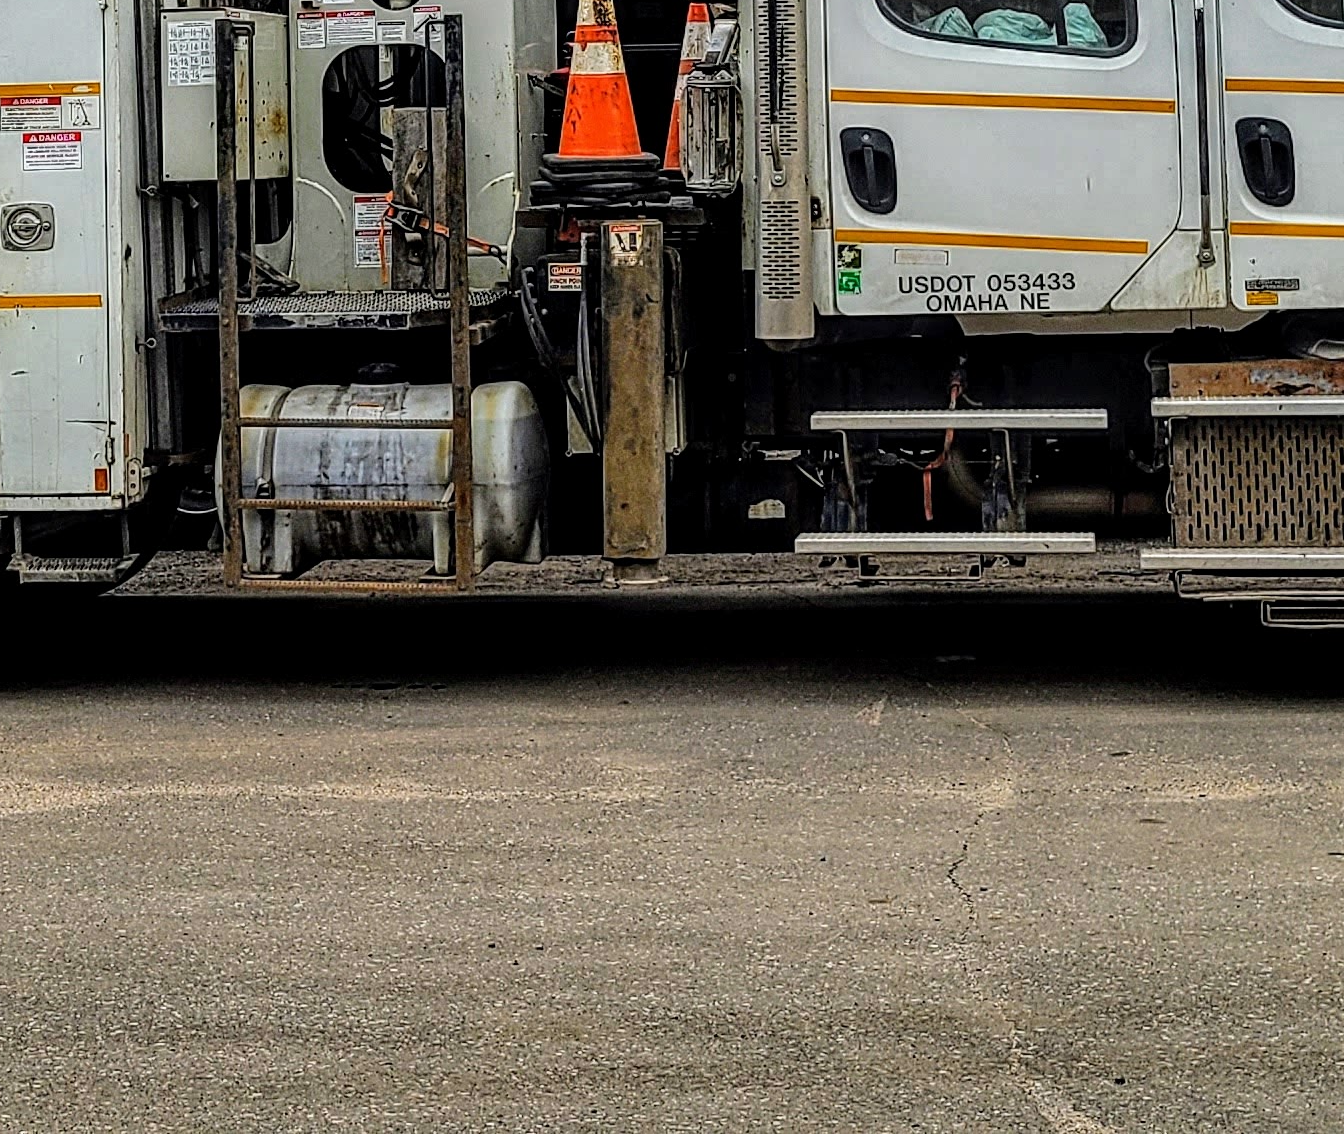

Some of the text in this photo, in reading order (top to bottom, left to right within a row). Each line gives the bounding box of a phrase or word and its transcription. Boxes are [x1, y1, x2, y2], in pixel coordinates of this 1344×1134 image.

[20, 97, 49, 105] DANGER
[38, 133, 76, 142] DANGER
[898, 272, 1076, 294] USDOT 053433
[926, 292, 1050, 312] OMAHA NE
